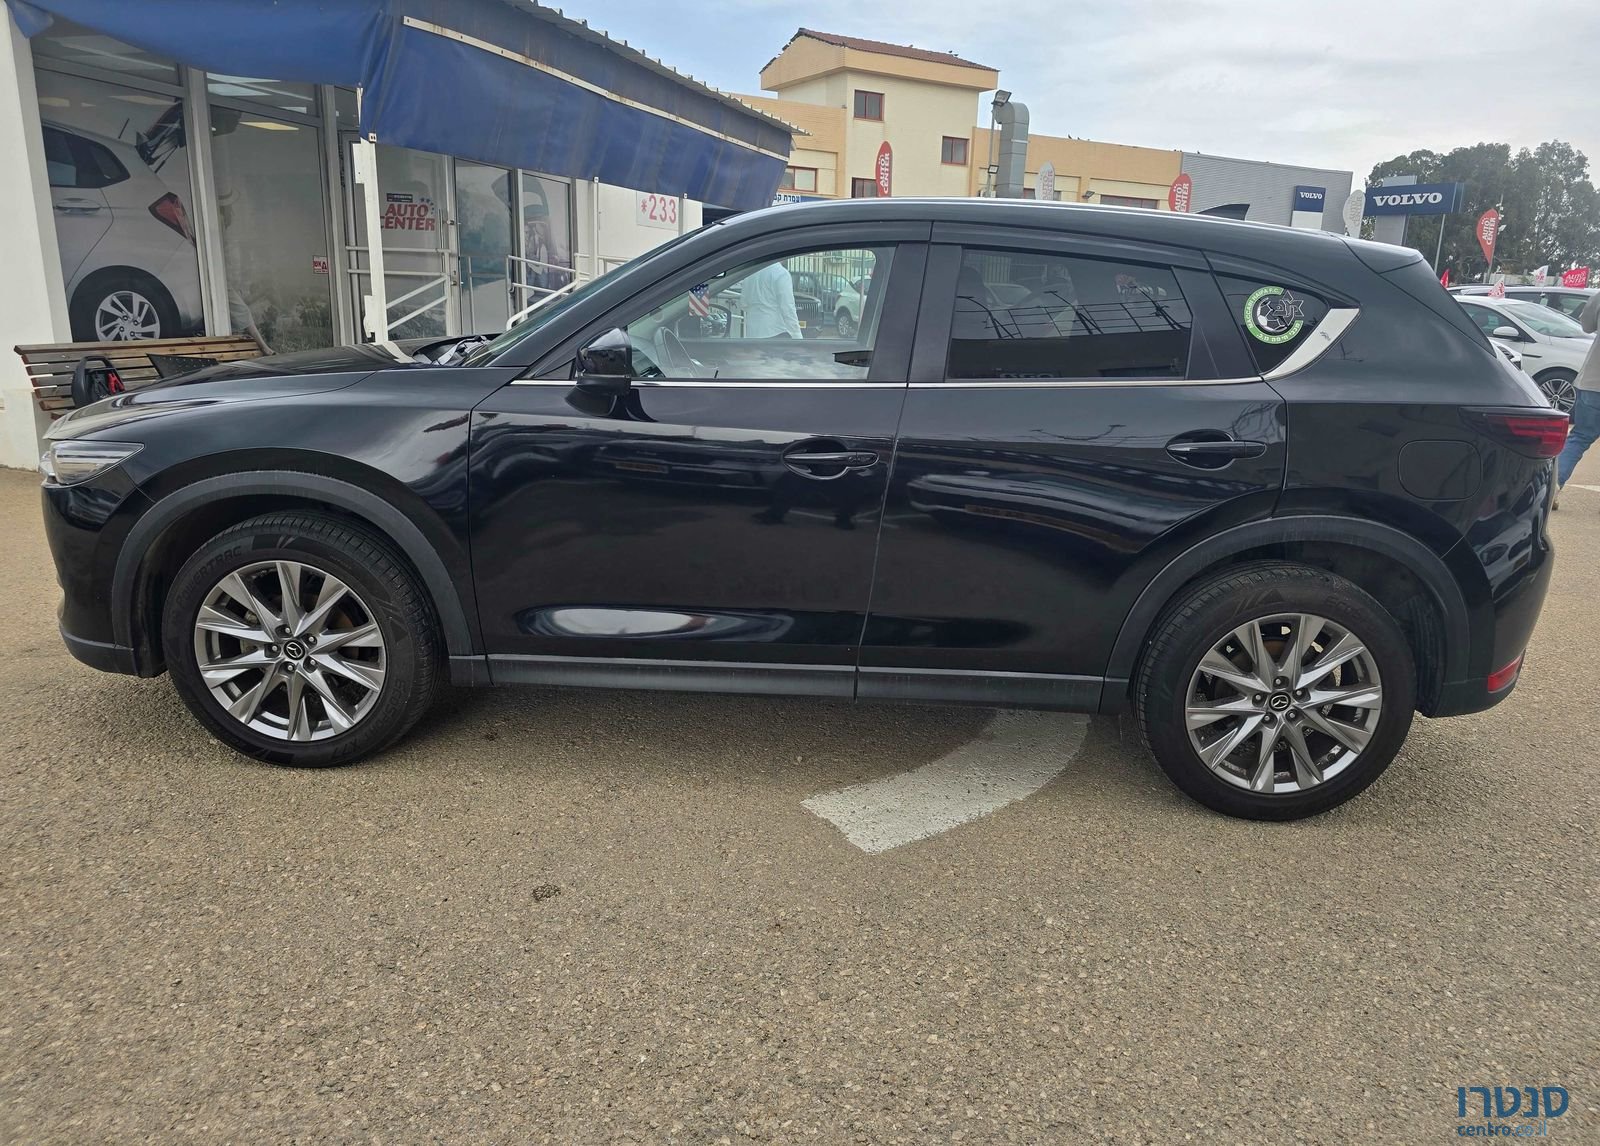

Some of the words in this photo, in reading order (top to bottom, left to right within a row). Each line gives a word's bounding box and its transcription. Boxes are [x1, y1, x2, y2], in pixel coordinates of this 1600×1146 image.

[1174, 187, 1183, 211] AUTO
[1300, 191, 1323, 200] VOLVO
[1372, 192, 1443, 207] VOLVO
[385, 203, 429, 218] AUTO
[1486, 217, 1496, 245] CENTER
